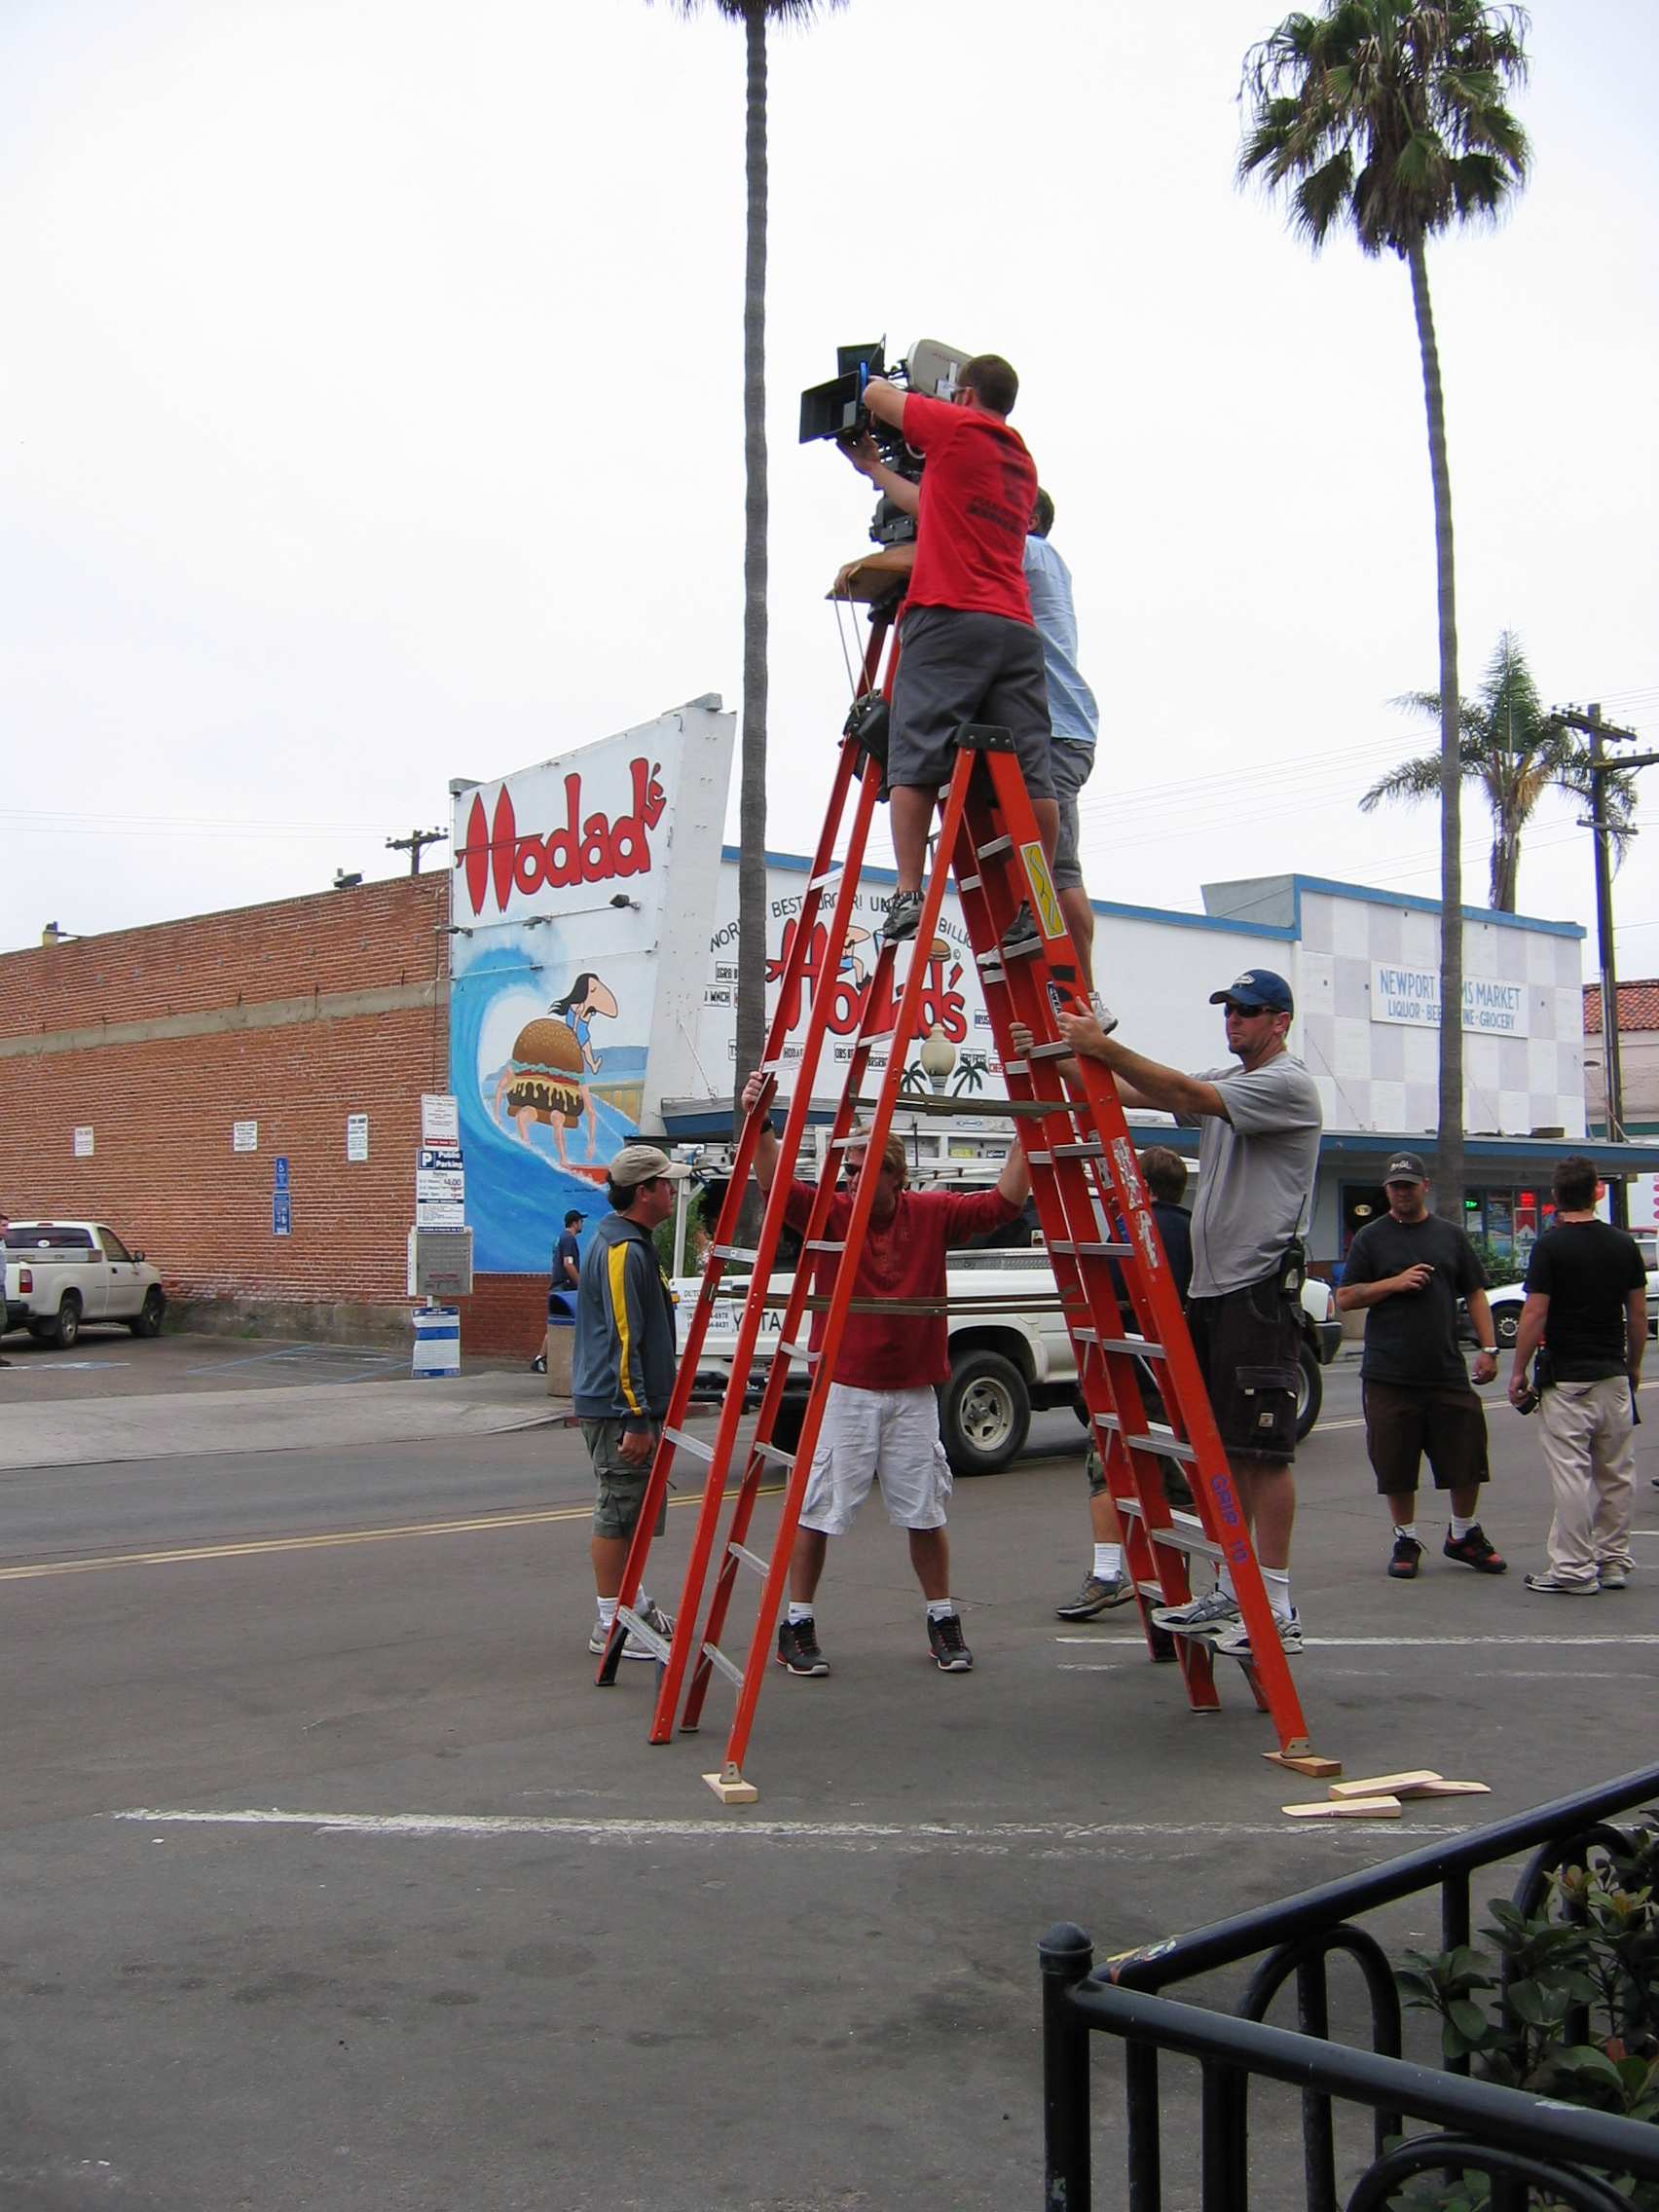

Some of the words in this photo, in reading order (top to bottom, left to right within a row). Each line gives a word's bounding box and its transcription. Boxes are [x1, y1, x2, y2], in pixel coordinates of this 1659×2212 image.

[455, 757, 667, 917] Hodad's
[764, 918, 968, 1044] Hod's
[1380, 969, 1435, 1000] NEWPORT
[1476, 982, 1522, 1012] MARKET
[1388, 1000, 1420, 1020] LIQUOR
[1479, 1011, 1516, 1030] GROCERY
